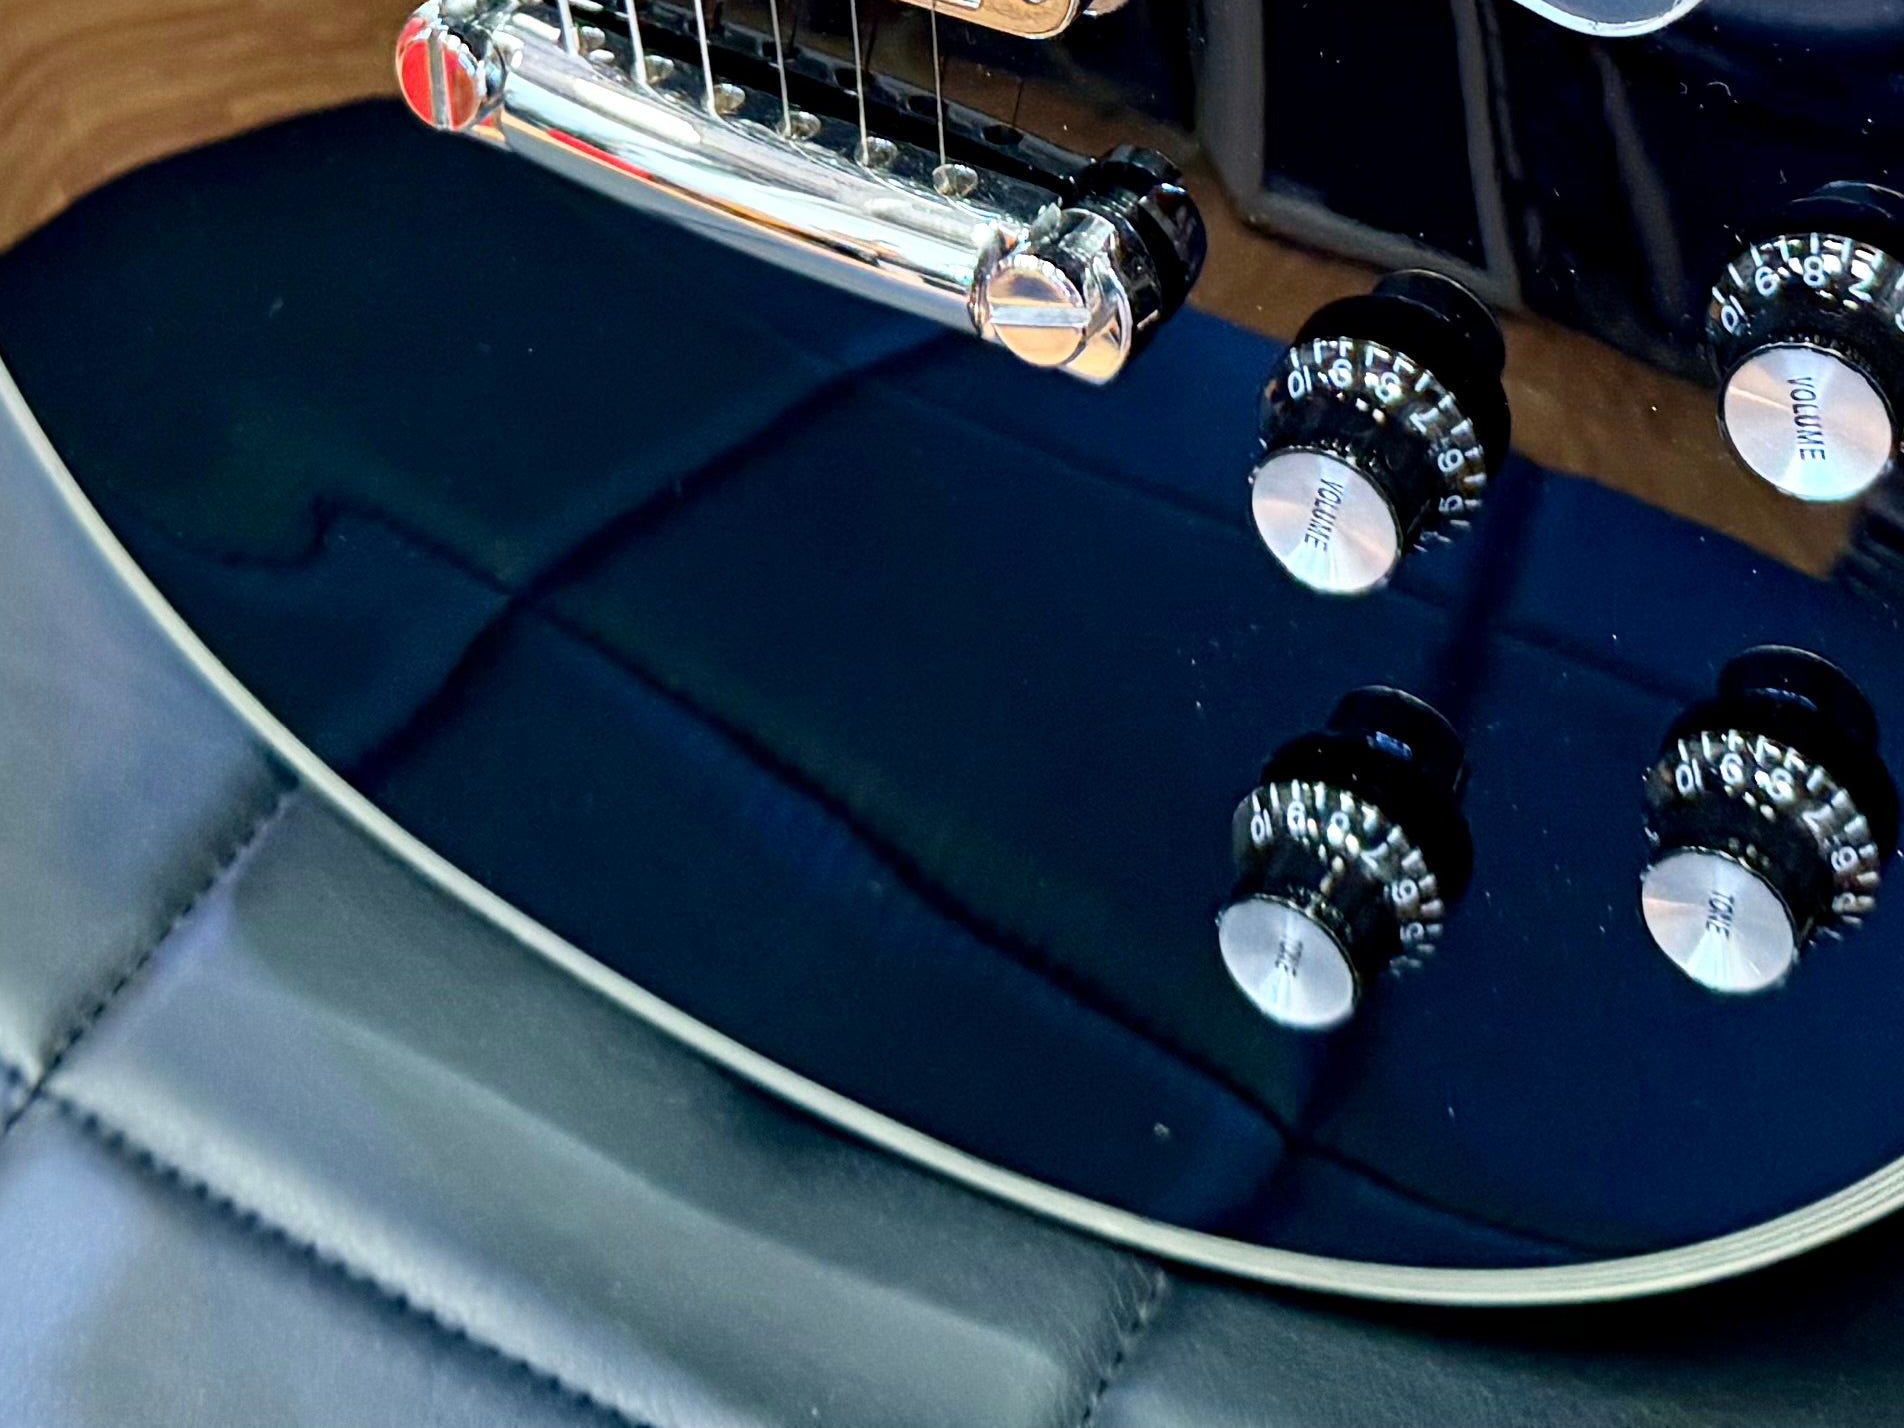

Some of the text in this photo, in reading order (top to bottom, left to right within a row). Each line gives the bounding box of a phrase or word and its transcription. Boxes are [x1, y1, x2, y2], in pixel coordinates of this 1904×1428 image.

[1803, 255, 1828, 288] 8
[1287, 364, 1313, 400] 10
[1786, 376, 1827, 462] VOLUME
[1437, 448, 1465, 474] 6
[1304, 478, 1344, 553] VOLUME
[1675, 757, 1704, 799] 10
[1706, 890, 1736, 939] TONE
